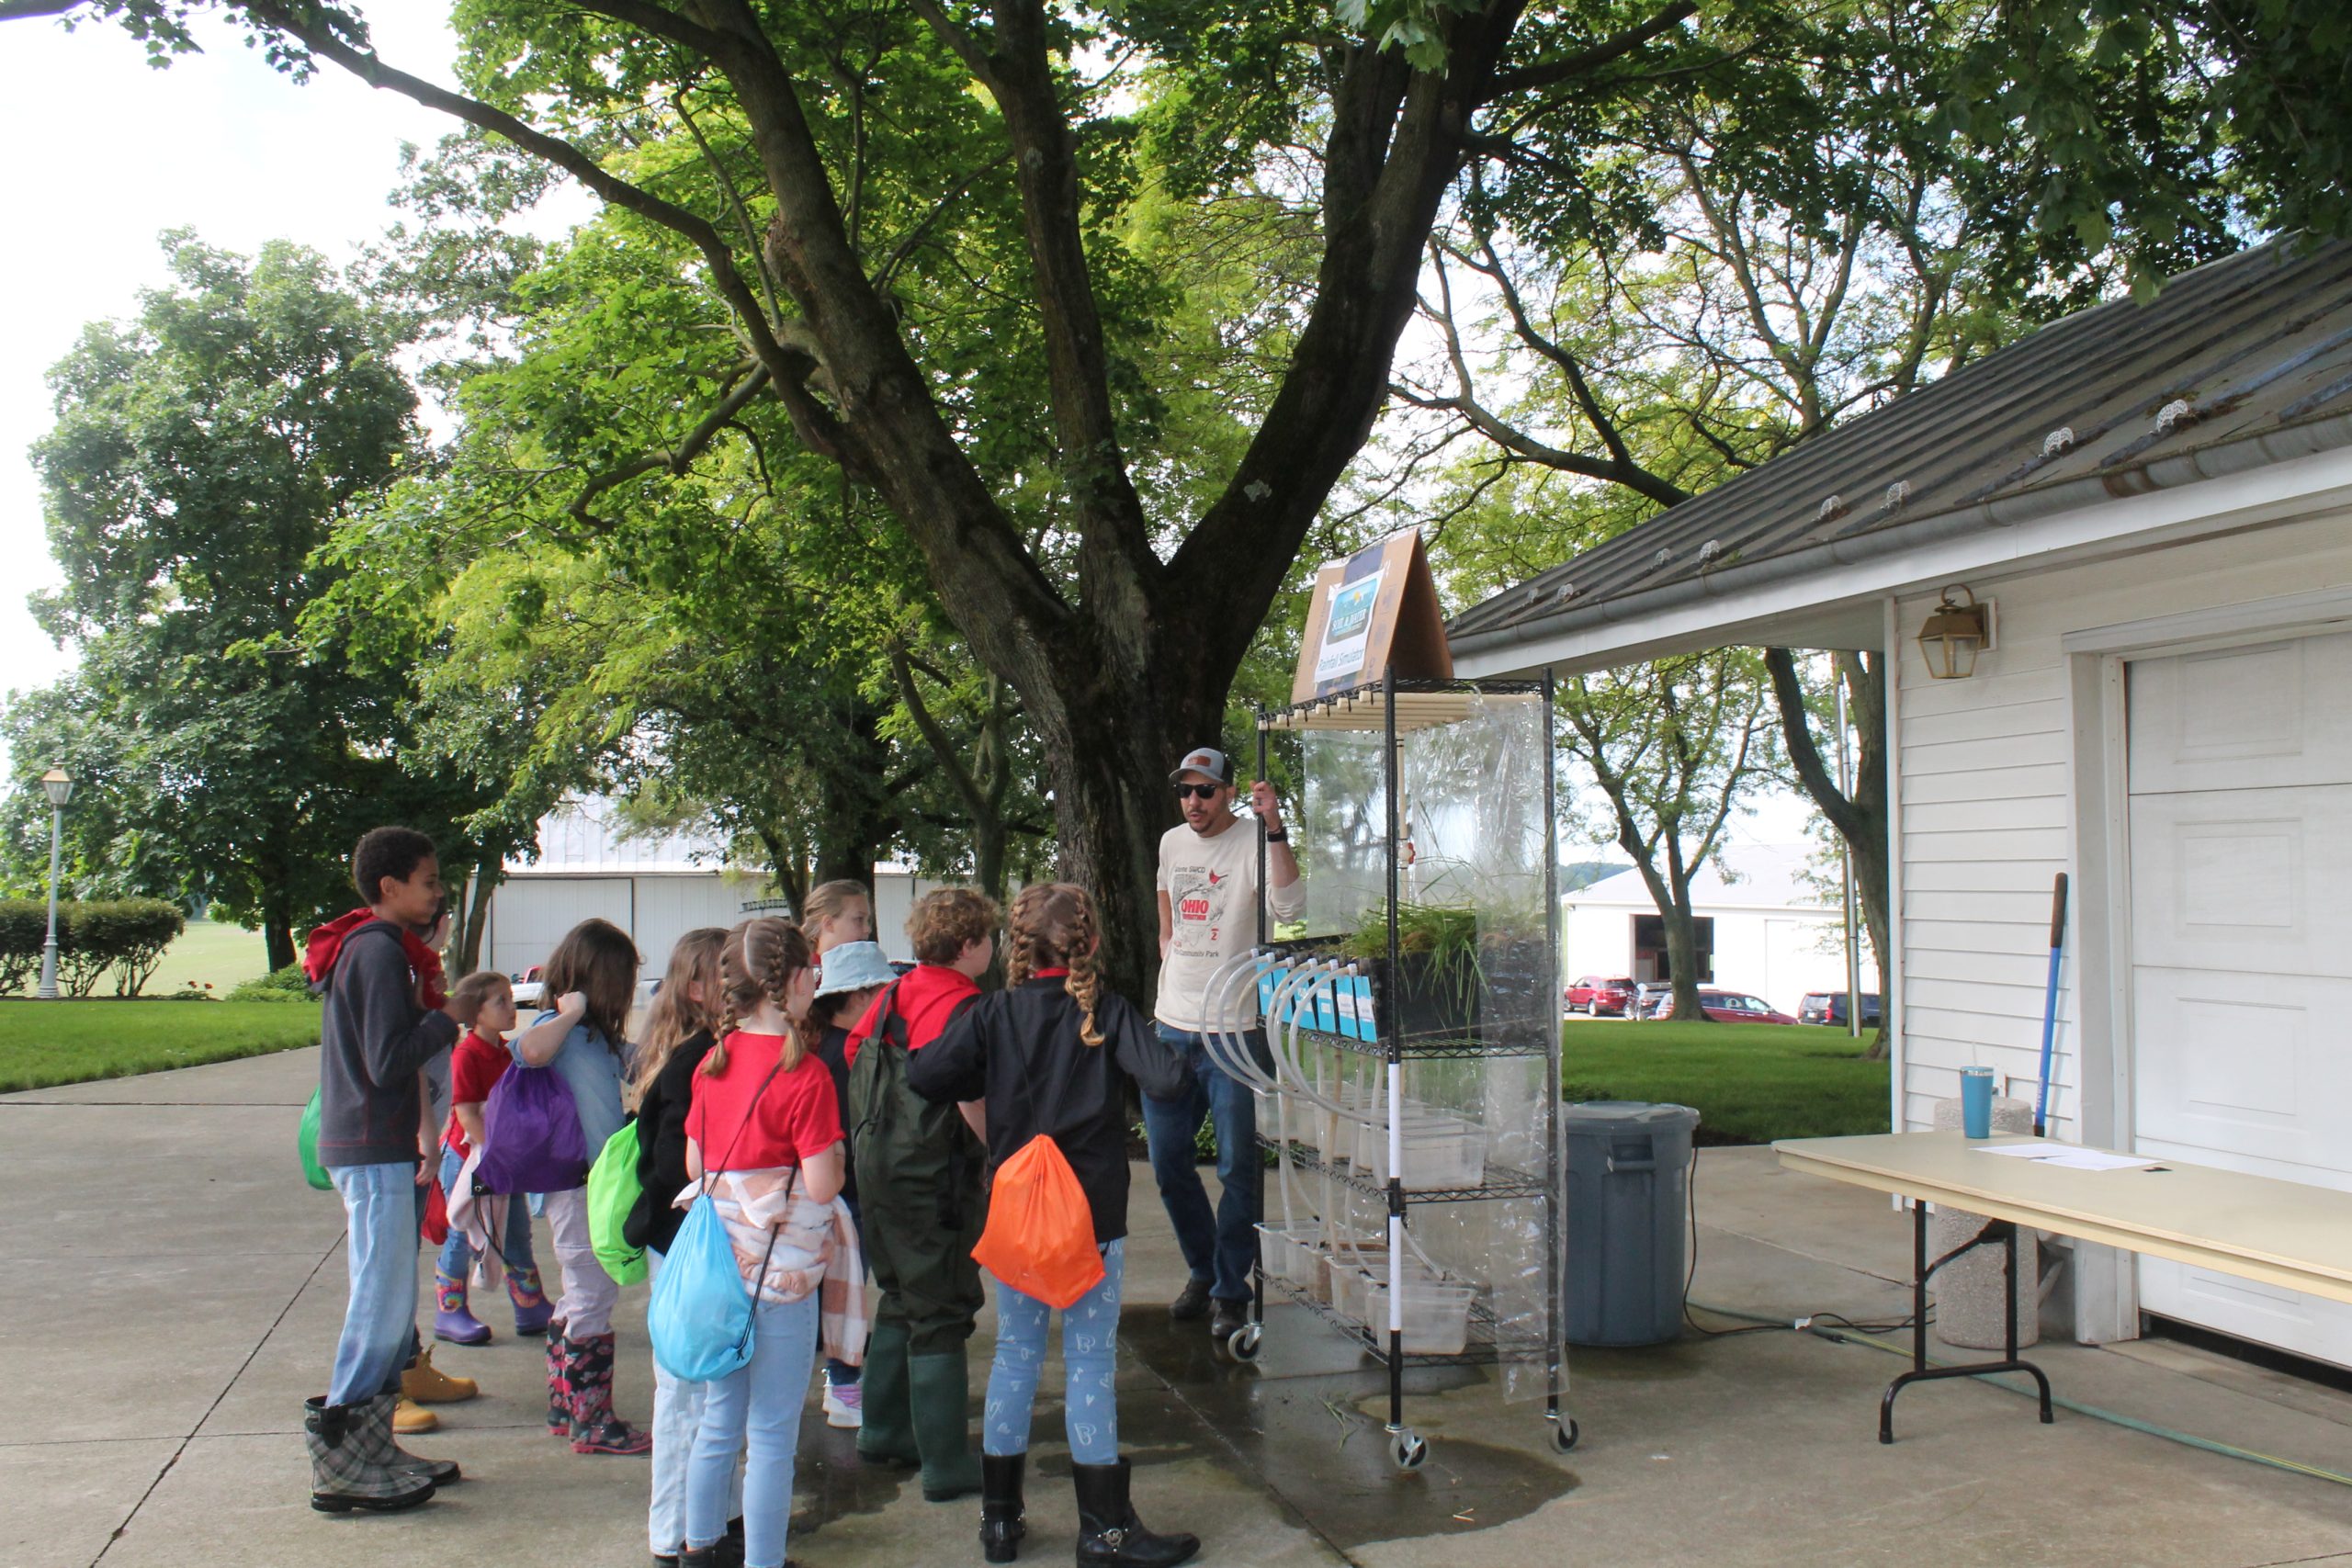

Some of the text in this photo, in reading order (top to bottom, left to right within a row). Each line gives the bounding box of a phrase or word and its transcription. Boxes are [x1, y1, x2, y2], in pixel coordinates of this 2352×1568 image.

[1318, 648, 1364, 671] Rainfall Simulator
[1182, 899, 1209, 914] OHIO
[1211, 932, 1217, 941] 2
